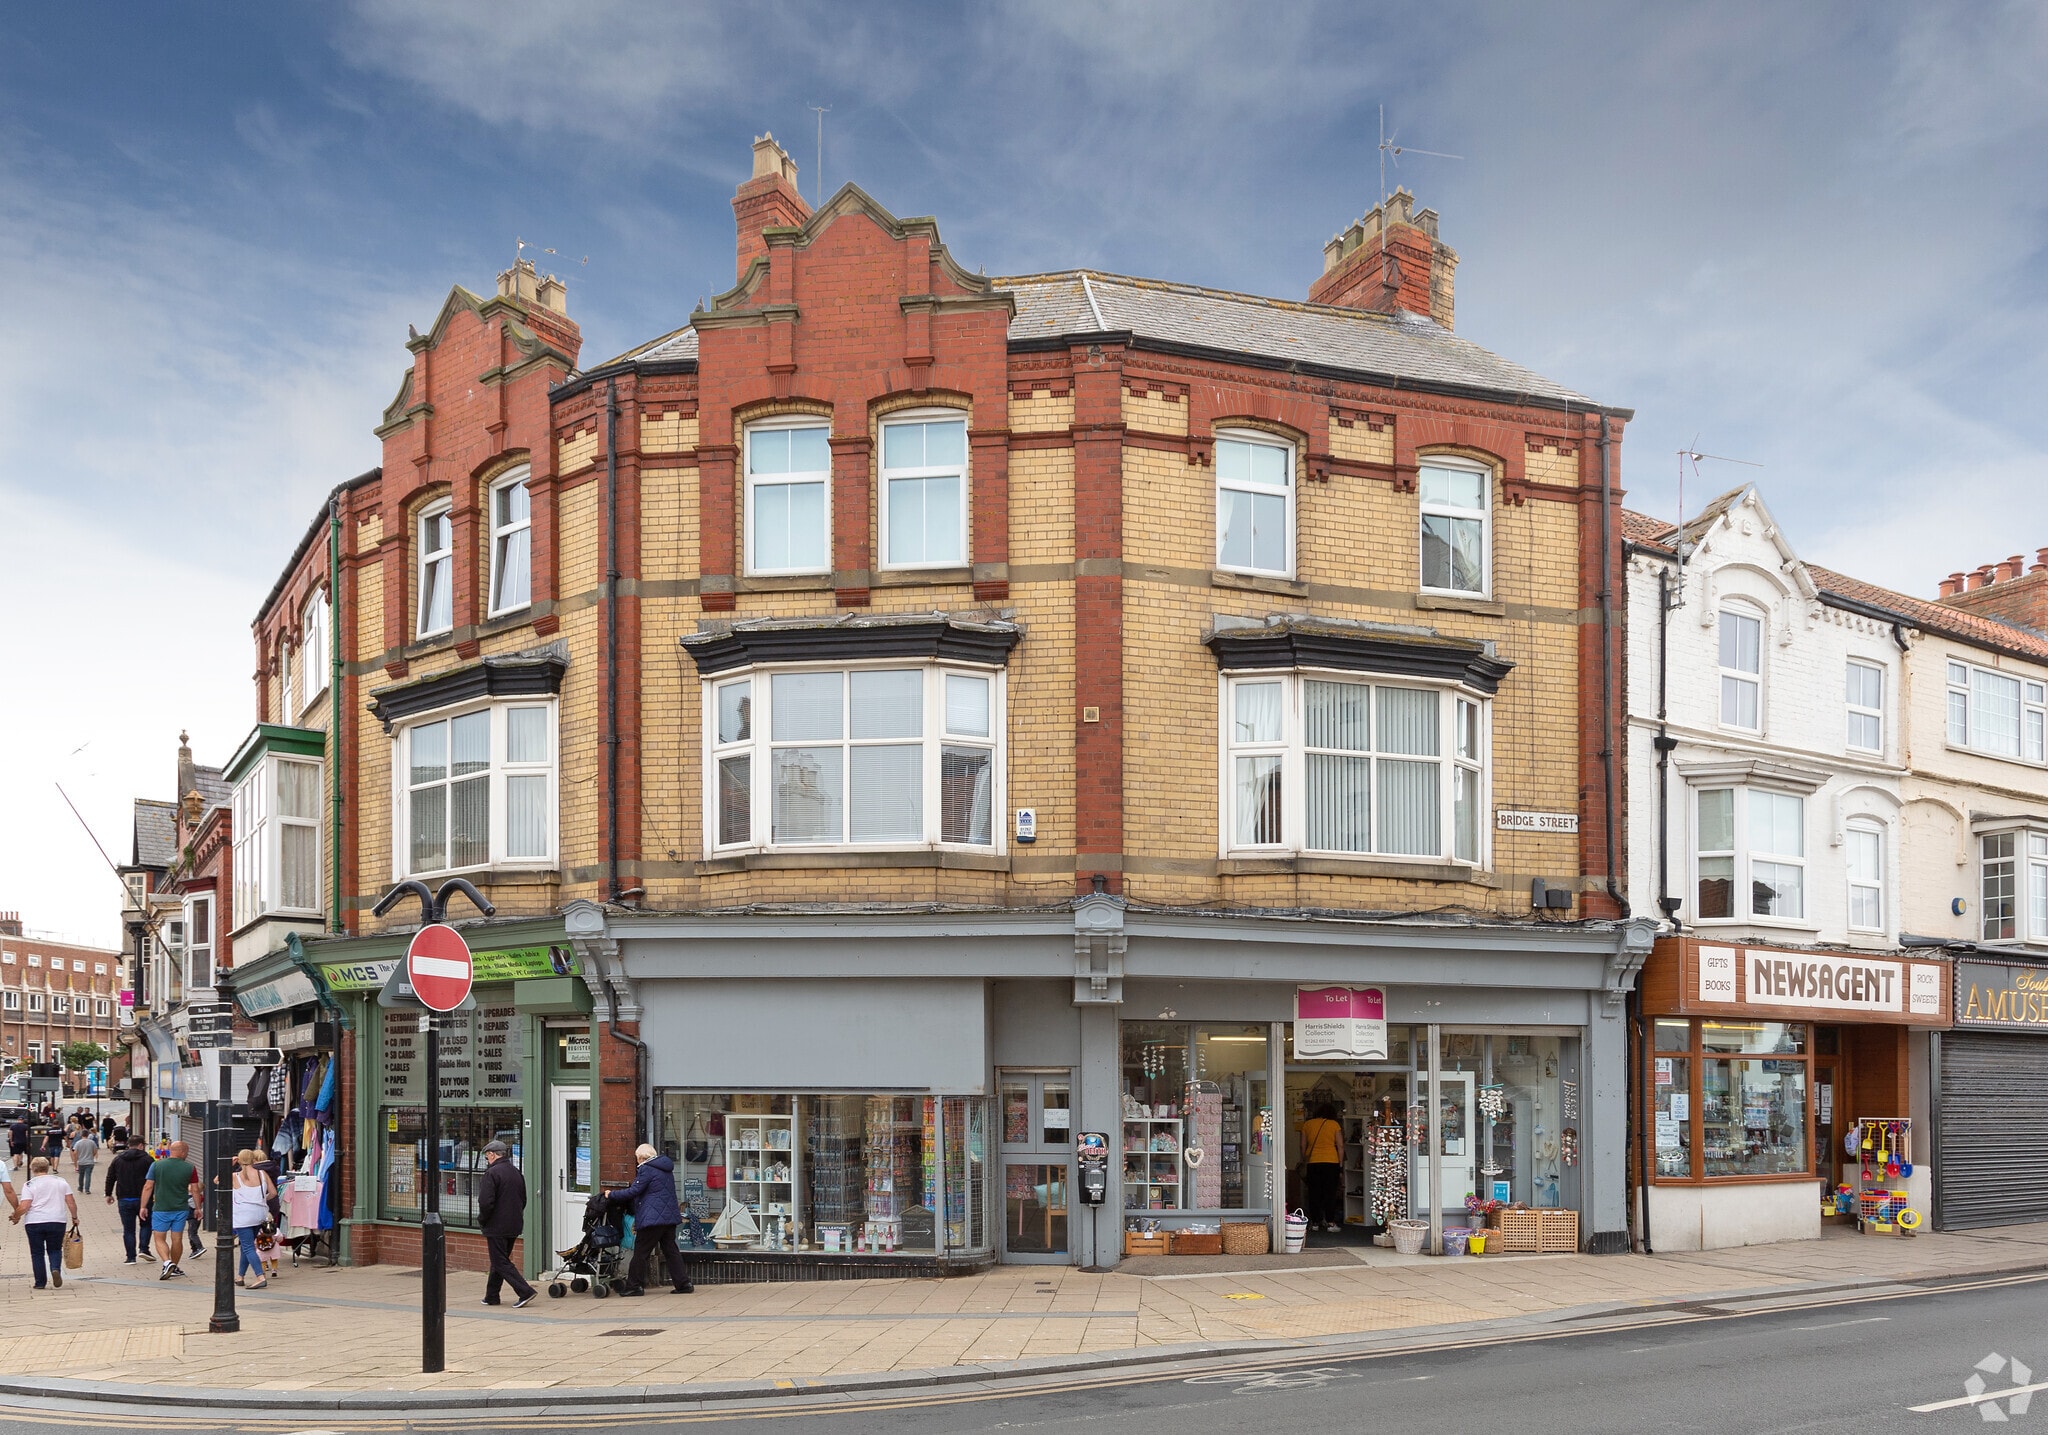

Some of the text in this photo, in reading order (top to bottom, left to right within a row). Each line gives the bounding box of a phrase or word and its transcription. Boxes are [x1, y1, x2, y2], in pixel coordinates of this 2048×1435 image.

[1500, 814, 1575, 829] BRIDGE STREET
[377, 962, 392, 973] The
[1707, 957, 1729, 969] GIFTS
[339, 966, 379, 982] MCS
[1916, 973, 1934, 985] ROCK
[1704, 978, 1732, 992] BOOKS
[1754, 957, 1896, 1003] NEWSAGENT
[1324, 994, 1348, 1003] To Let
[1367, 996, 1382, 1004] To Let
[1911, 993, 1938, 1006] SWEETS
[389, 1012, 420, 1023] KEYBOARDS
[483, 1007, 516, 1018] UPGRADES
[389, 1025, 420, 1035] HARDWARE
[483, 1021, 510, 1032] REPAIRS
[1304, 1029, 1336, 1037] Collection
[389, 1038, 398, 1047] CD
[452, 1035, 468, 1046] USED
[483, 1034, 507, 1045] ADVICE
[389, 1050, 416, 1060] SD CARDS
[483, 1048, 503, 1058] SALES
[389, 1062, 410, 1072] CABLES
[456, 1059, 472, 1069] Here
[483, 1061, 503, 1071] VIRUS
[389, 1075, 408, 1084] PAPER
[440, 1076, 470, 1086] BUY YOUR
[488, 1073, 518, 1084] REMOVAL
[389, 1087, 404, 1097] MICE
[442, 1089, 470, 1099] LAPTOPS
[483, 1087, 512, 1098] SUPPORT
